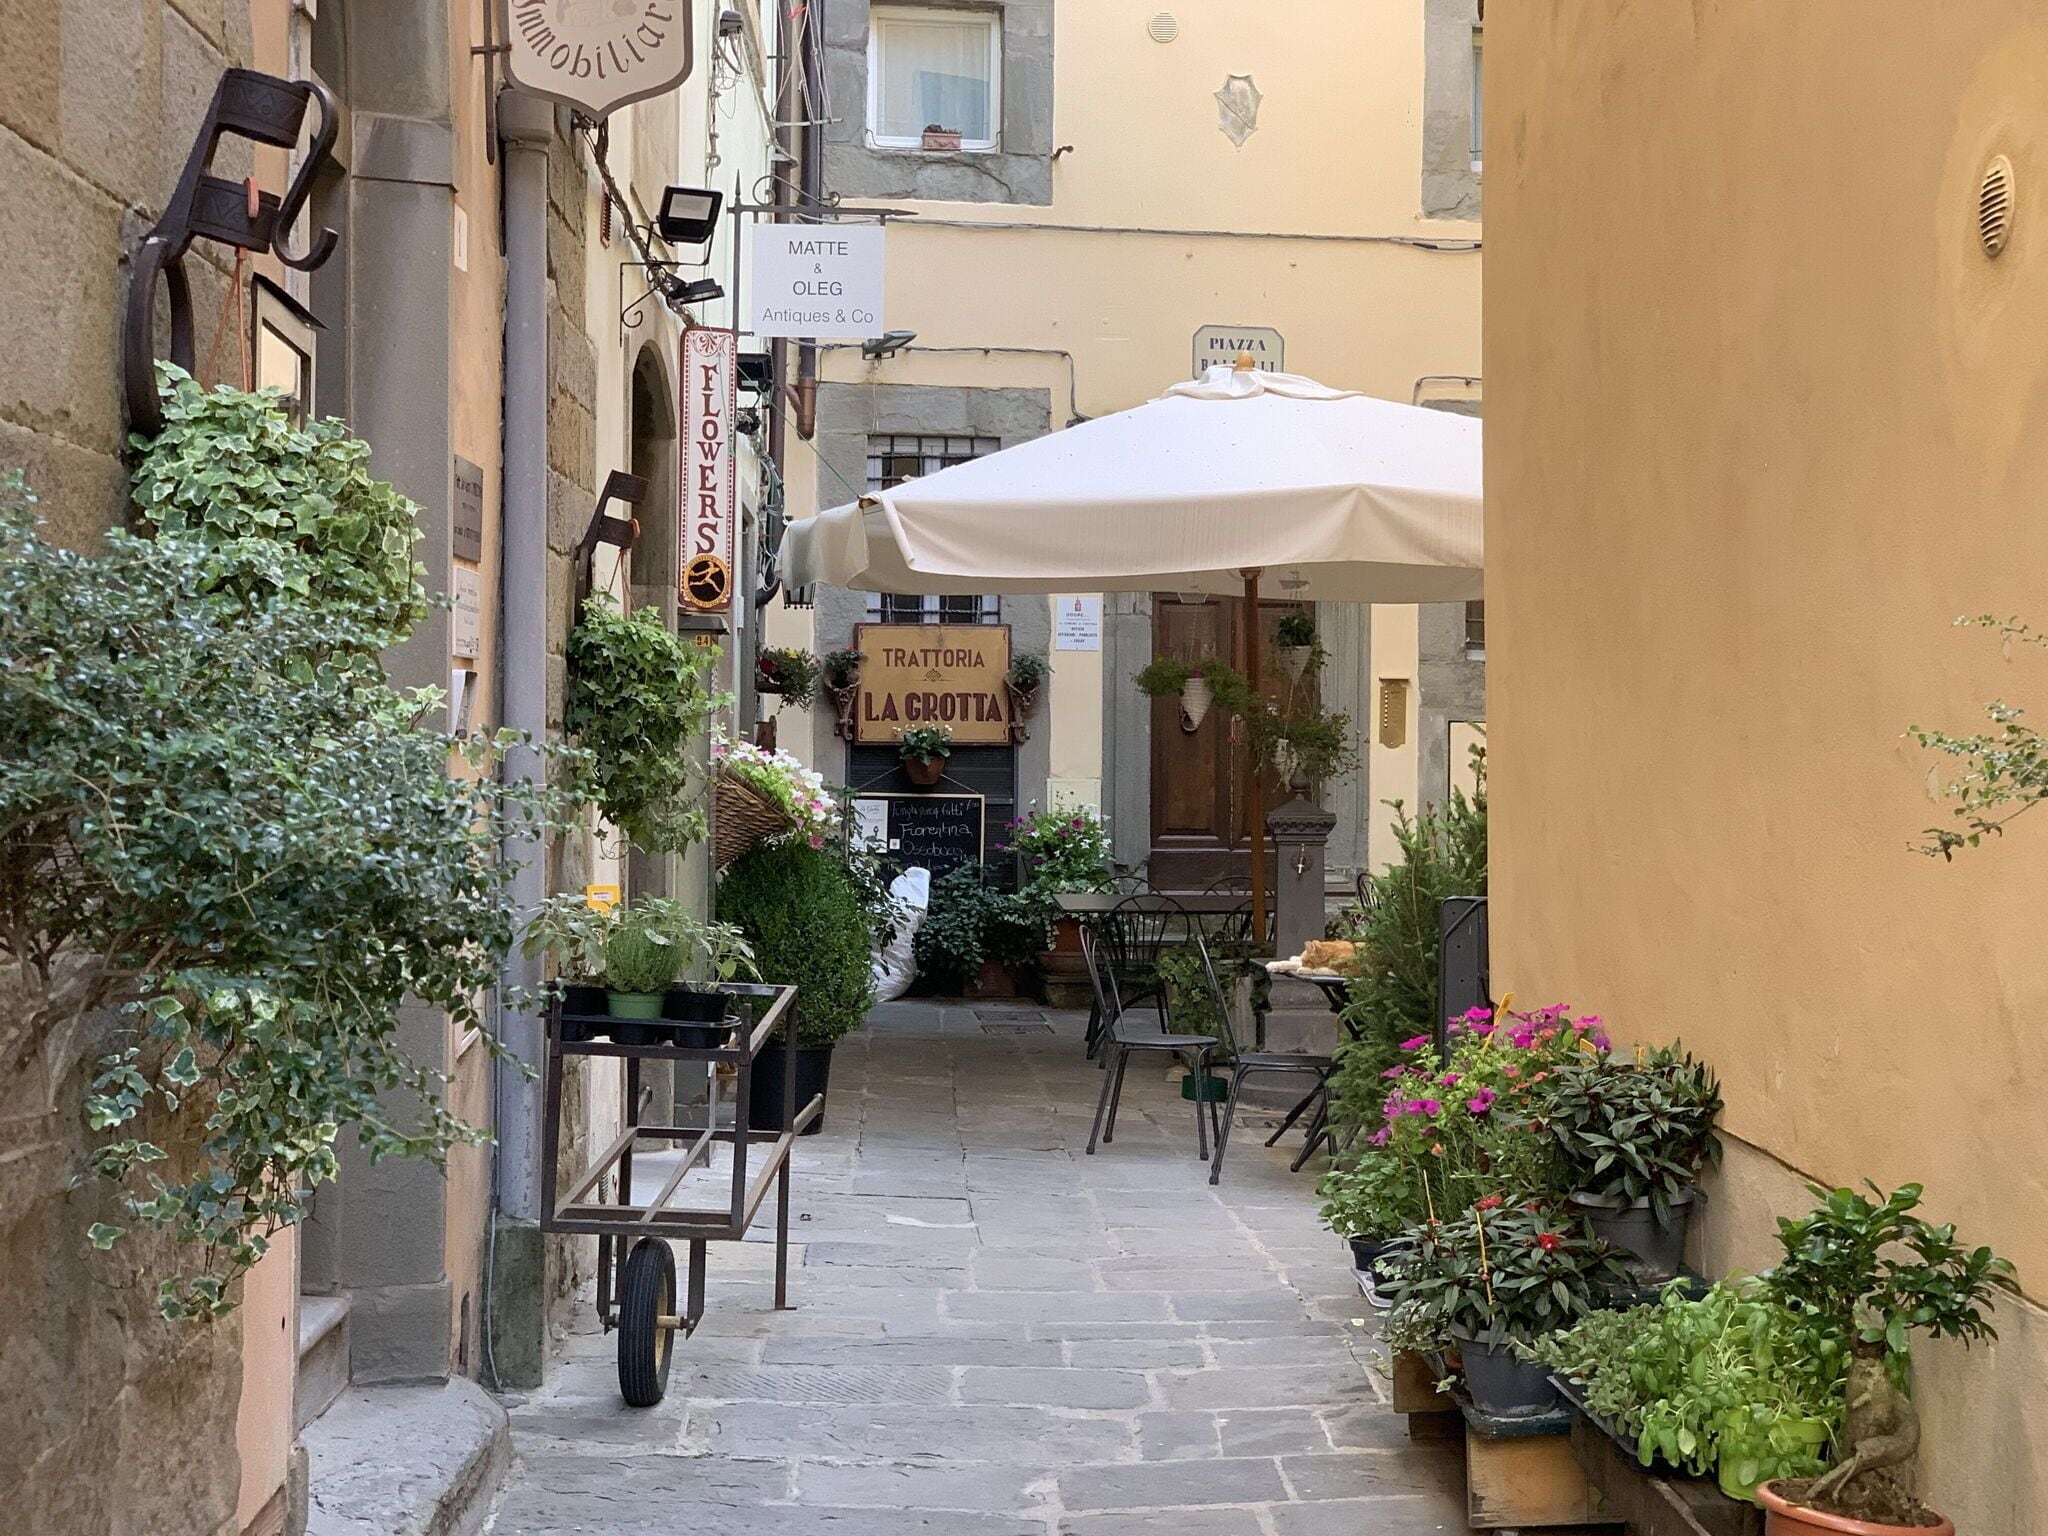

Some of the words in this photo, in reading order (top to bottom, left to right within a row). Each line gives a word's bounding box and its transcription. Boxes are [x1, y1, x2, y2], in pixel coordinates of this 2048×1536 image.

[512, 0, 677, 79] Immobiliar
[788, 240, 849, 256] MATTE
[813, 262, 823, 274] &
[792, 280, 844, 296] OLEG
[762, 307, 830, 325] Antiques
[835, 308, 847, 324] &
[851, 308, 874, 324] Co
[1209, 337, 1267, 352] PIAZZA
[694, 363, 725, 556] FLOWERS
[882, 647, 985, 668] TRATTORIA
[864, 691, 899, 722] LA
[904, 691, 1003, 723] GROTTA
